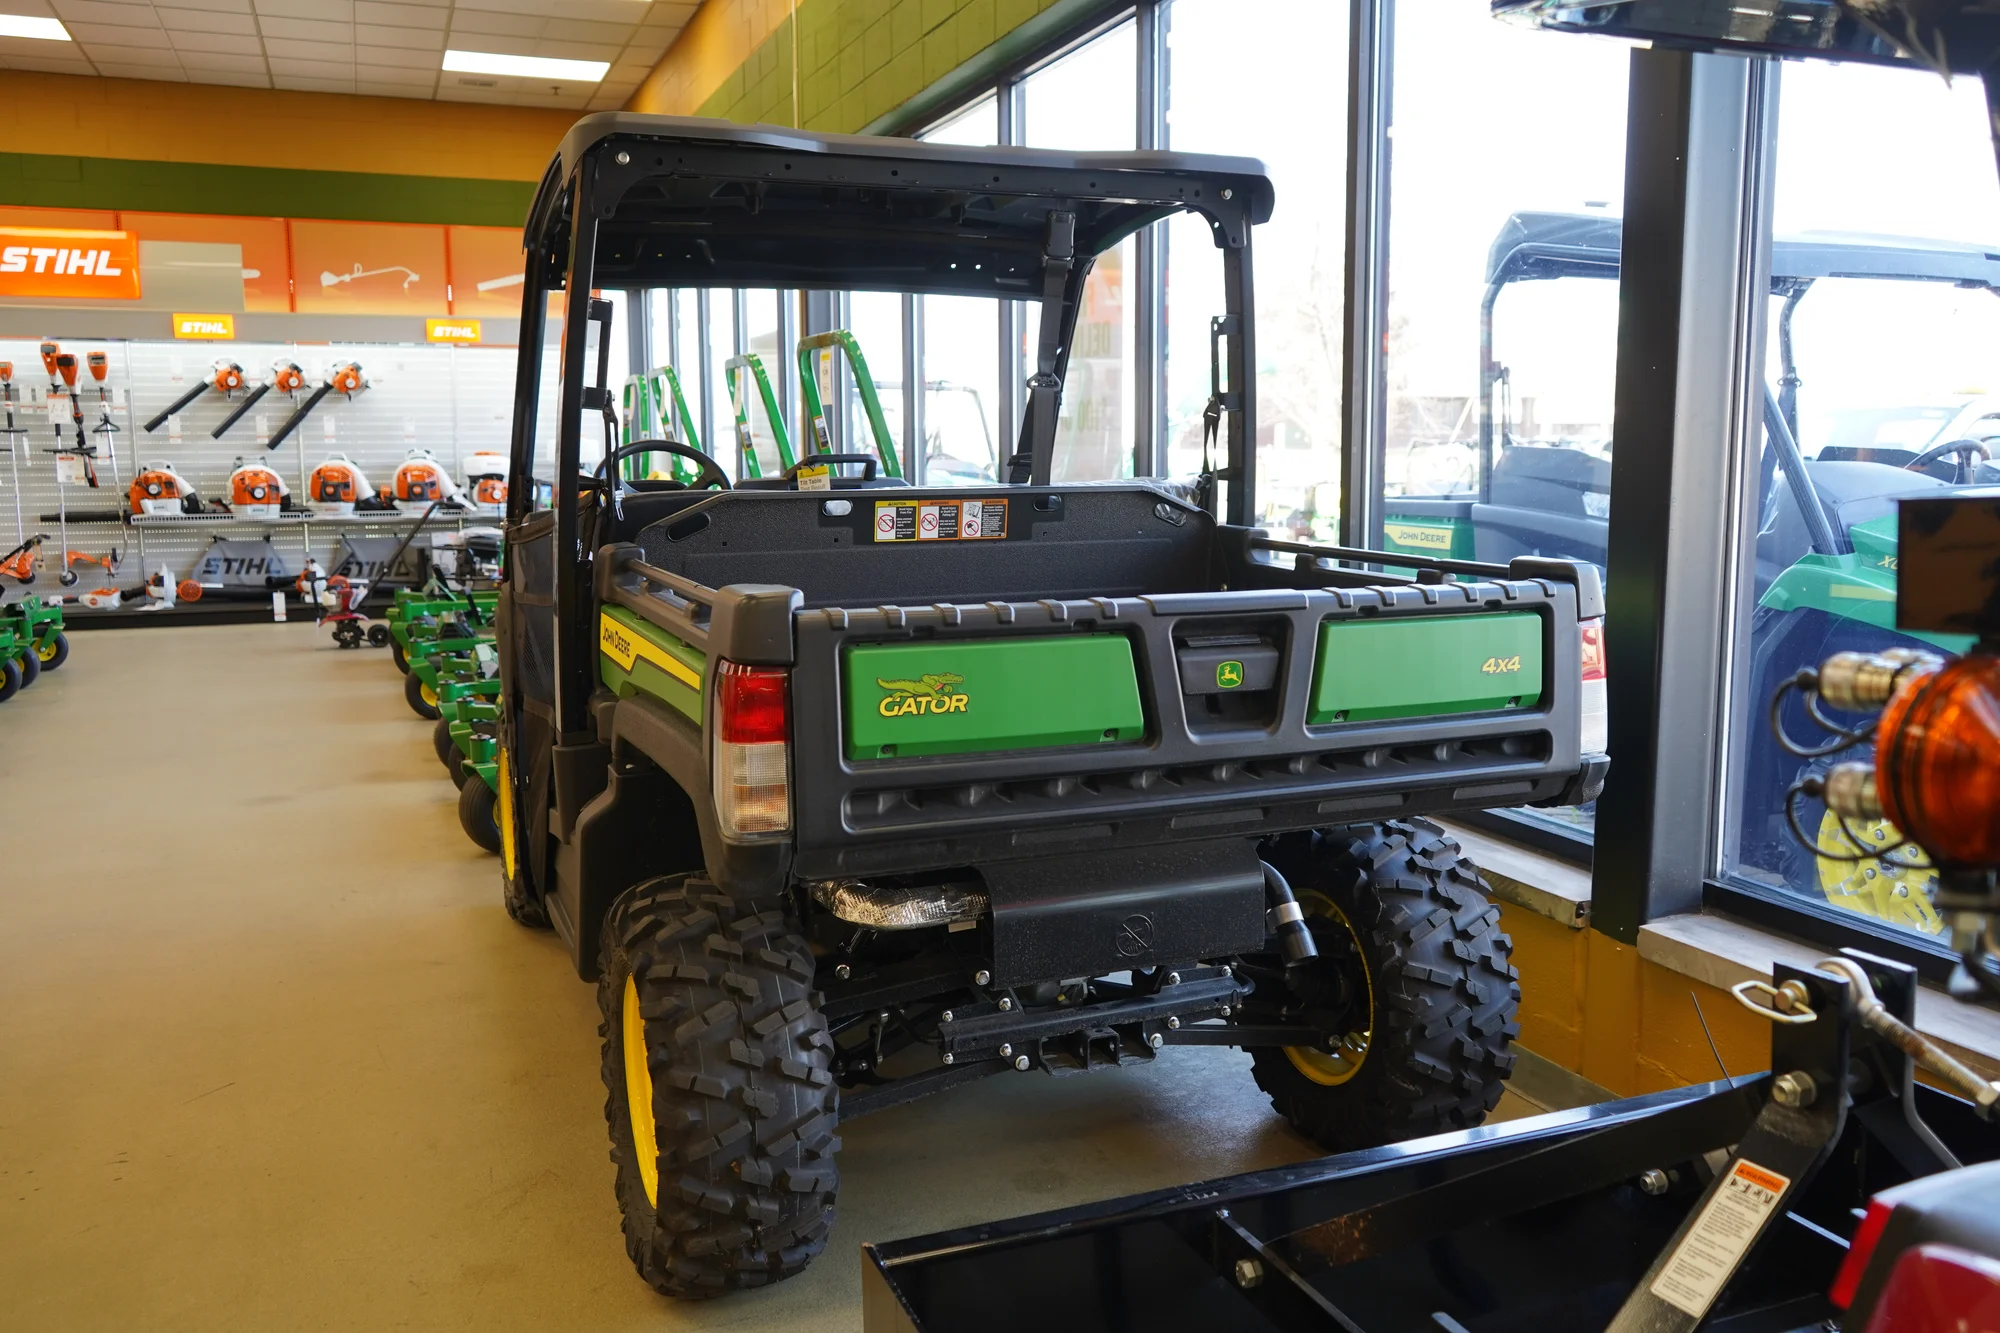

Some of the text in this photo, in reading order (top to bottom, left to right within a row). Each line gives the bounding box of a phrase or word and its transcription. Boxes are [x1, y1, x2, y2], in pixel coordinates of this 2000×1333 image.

[0, 246, 122, 276] STIHL
[181, 321, 227, 334] STIHL
[433, 325, 476, 338] STIHL
[1398, 530, 1447, 544] JOHN DEERE
[202, 557, 281, 575] STIHL
[602, 623, 631, 658] JOHN DEERE
[879, 693, 970, 717] GATOR
